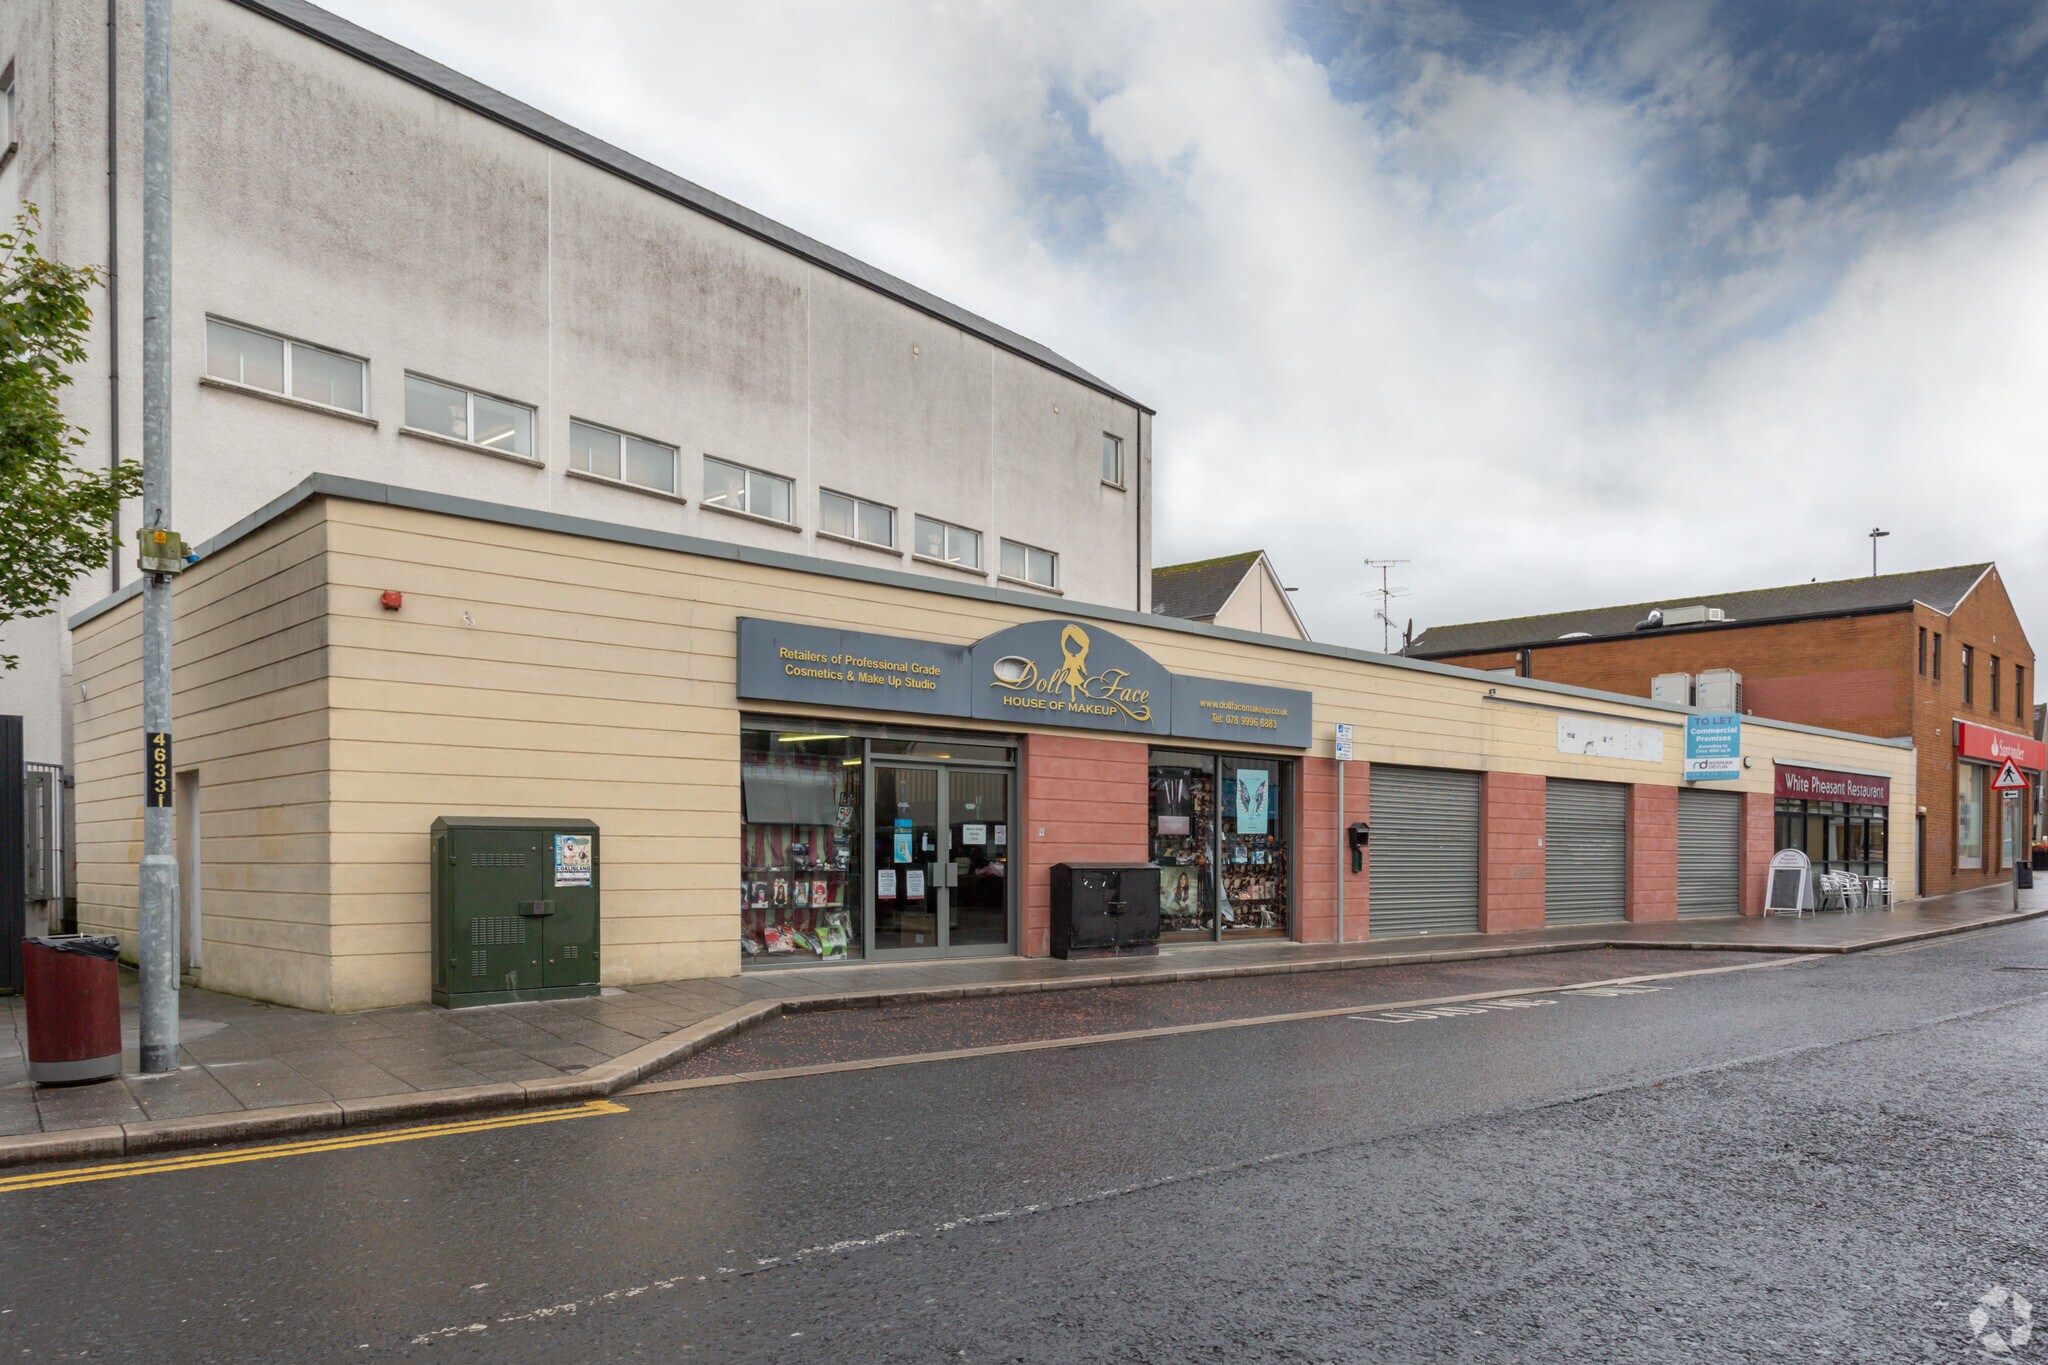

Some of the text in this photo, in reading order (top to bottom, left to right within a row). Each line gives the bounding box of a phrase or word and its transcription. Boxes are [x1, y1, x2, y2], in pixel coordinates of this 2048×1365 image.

[779, 647, 941, 676] Retailers of Professional Grade
[785, 664, 937, 691] Cosmetics & Make Up Studio
[990, 655, 1151, 710] Doll Face
[1003, 696, 1118, 717] HOUSE OF MAKEUP
[1199, 699, 1289, 717] www.dollfacemakeup.co.uk
[1225, 714, 1239, 726] 078
[1240, 716, 1259, 728] 9996
[1260, 718, 1278, 729] 6883
[1690, 726, 1738, 735] Commercial
[1694, 716, 1734, 726] TO LET
[1999, 739, 2025, 761] Santander
[152, 732, 167, 809] 46331
[1784, 773, 1884, 799] White Pheasant Restaurant
[1347, 998, 1559, 1023] LOADING
